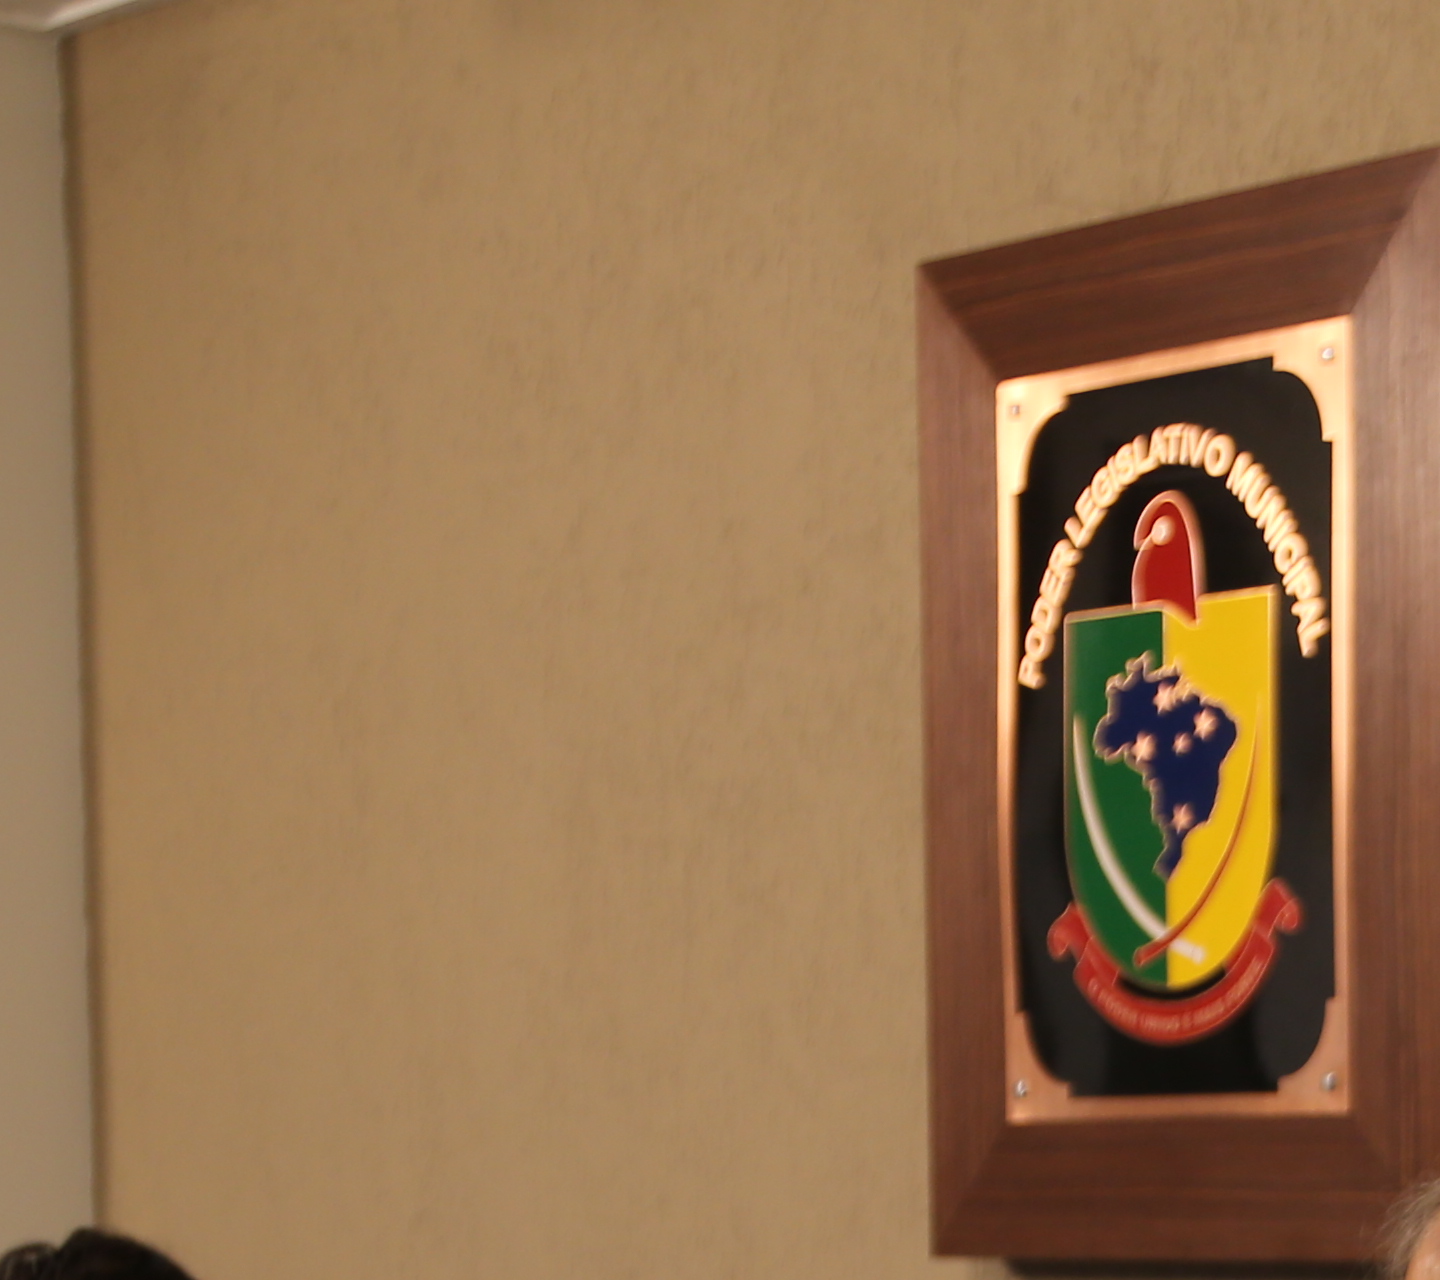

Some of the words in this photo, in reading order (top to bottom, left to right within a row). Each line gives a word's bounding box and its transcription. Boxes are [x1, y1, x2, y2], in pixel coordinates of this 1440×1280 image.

[1017, 537, 1084, 691] PODER
[1064, 421, 1237, 550] LEGISLATIVO
[1225, 450, 1331, 659] MUNICIPAL
